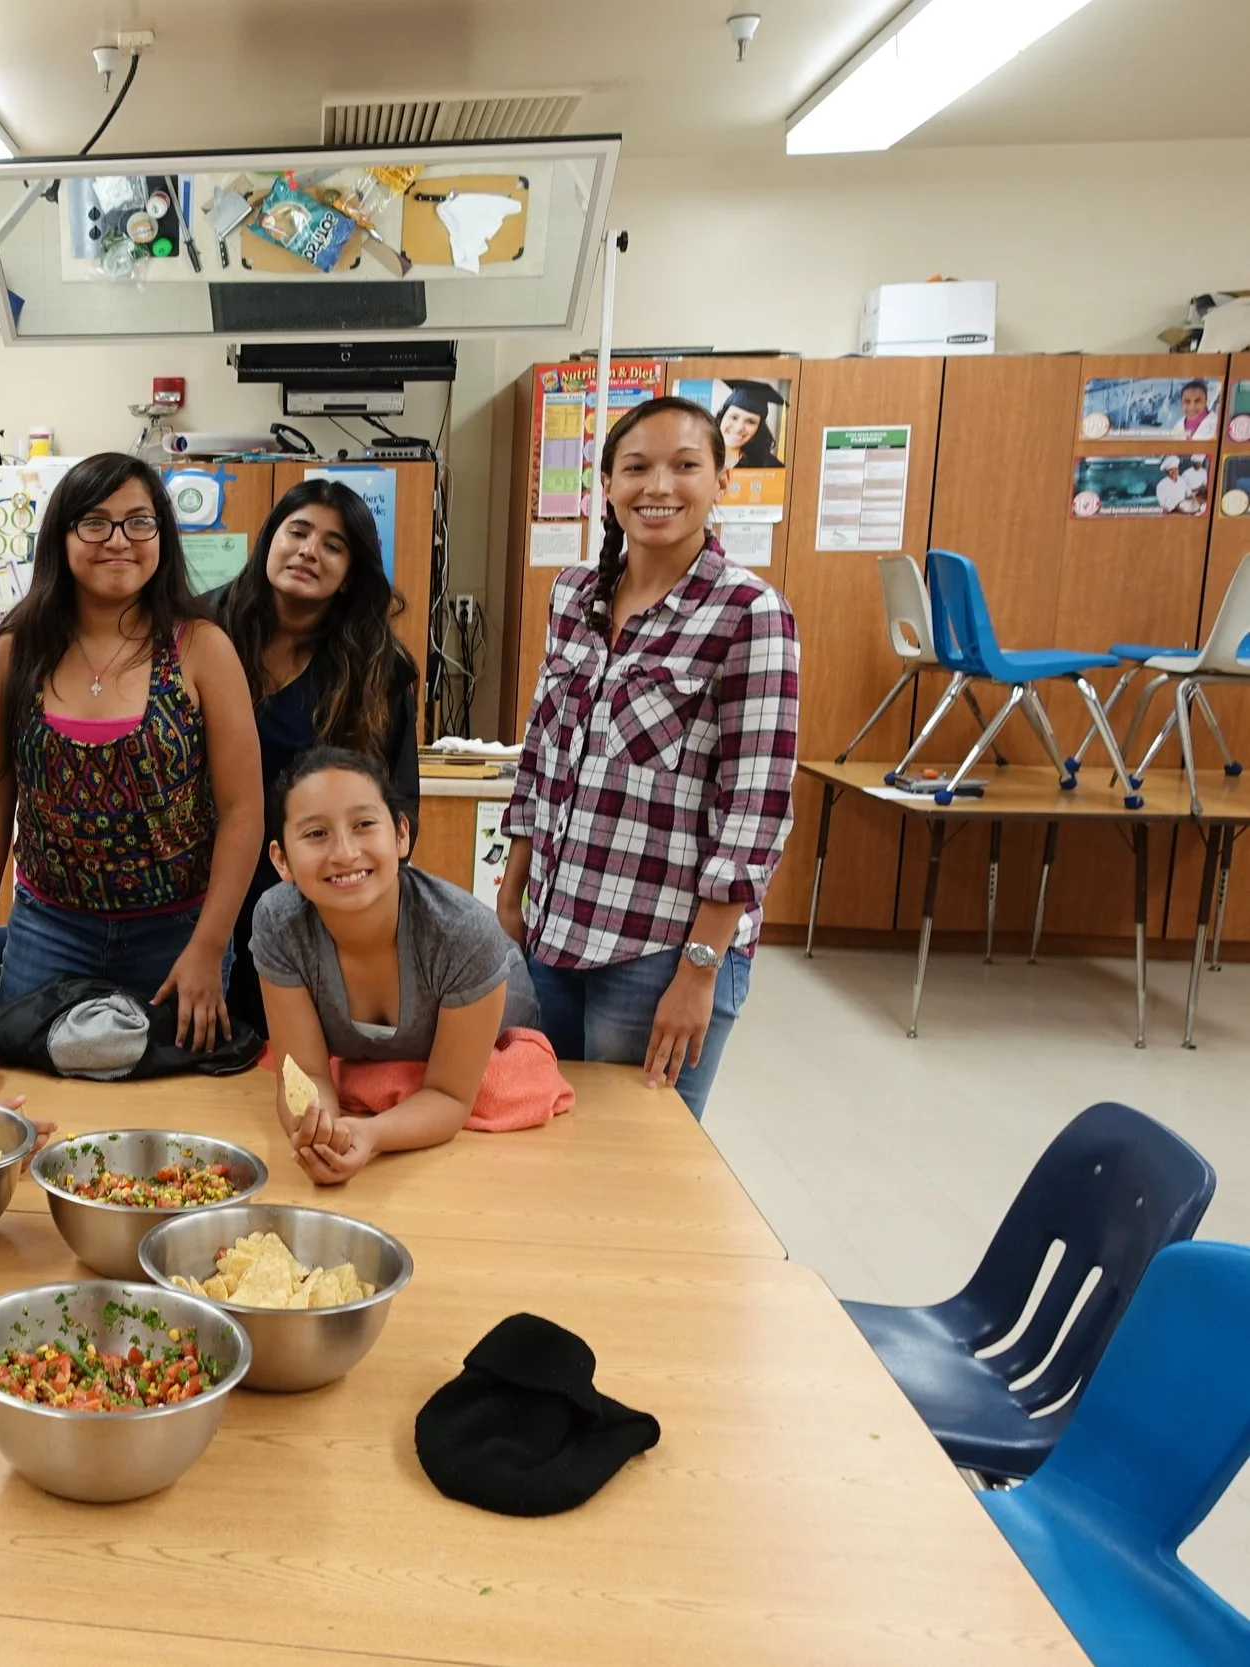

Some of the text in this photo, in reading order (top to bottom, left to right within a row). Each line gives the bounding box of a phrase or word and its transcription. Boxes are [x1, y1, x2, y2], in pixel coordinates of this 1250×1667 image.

[561, 366, 654, 381] Nutritn & Diet
